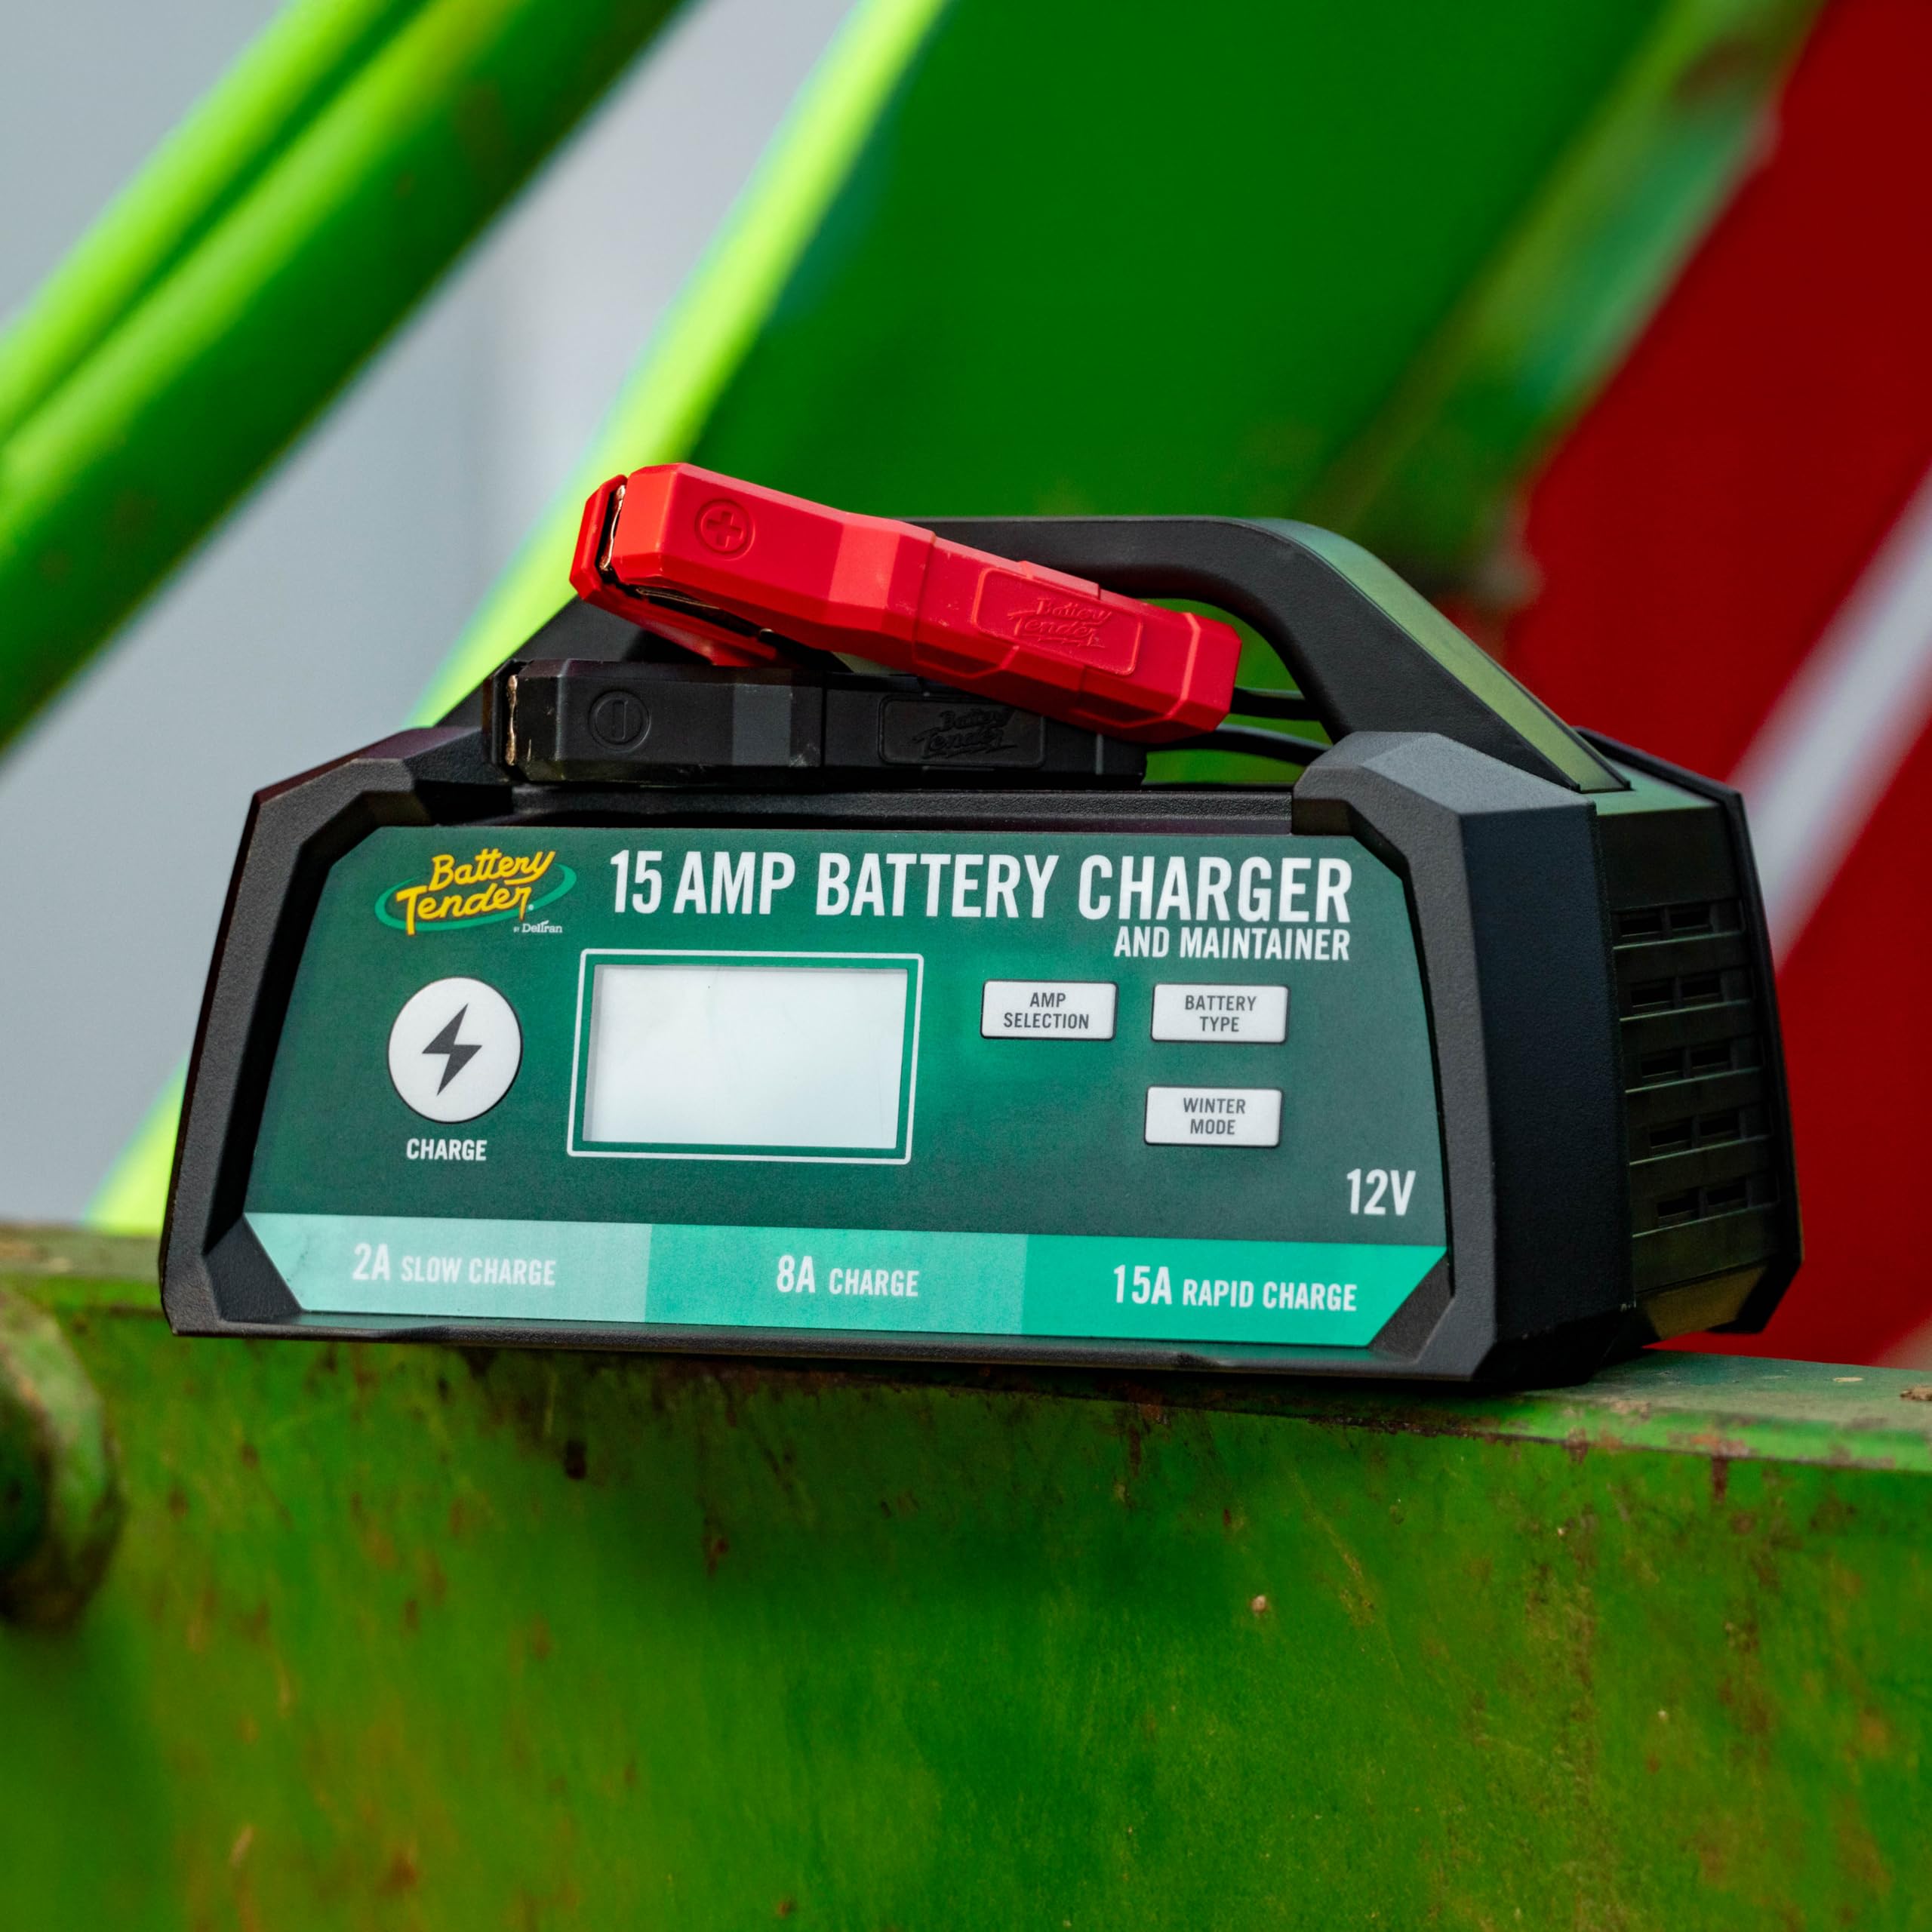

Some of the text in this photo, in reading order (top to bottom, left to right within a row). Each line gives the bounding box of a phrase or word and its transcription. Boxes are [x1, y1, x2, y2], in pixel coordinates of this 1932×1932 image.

[427, 848, 555, 891] Battery
[610, 850, 1353, 923] 15 AMP BATTERY CHARGER
[395, 882, 532, 936] Tender
[1113, 925, 1350, 961] AND MAINTAINER
[1029, 992, 1066, 1008] AMP
[1184, 995, 1257, 1012] BATTERY
[1003, 1012, 1090, 1030] SELECTION
[1199, 1016, 1240, 1033] TYPE
[1183, 1097, 1246, 1115] WINTER
[1189, 1118, 1235, 1135] MODE
[406, 1138, 488, 1161] CHARGE
[1346, 1168, 1416, 1216] 12V
[352, 1242, 556, 1287] 2A SLOW CHARGE
[776, 1254, 920, 1297] 8A CHARGE
[1113, 1264, 1358, 1312] 15A RAPID CHARGE
